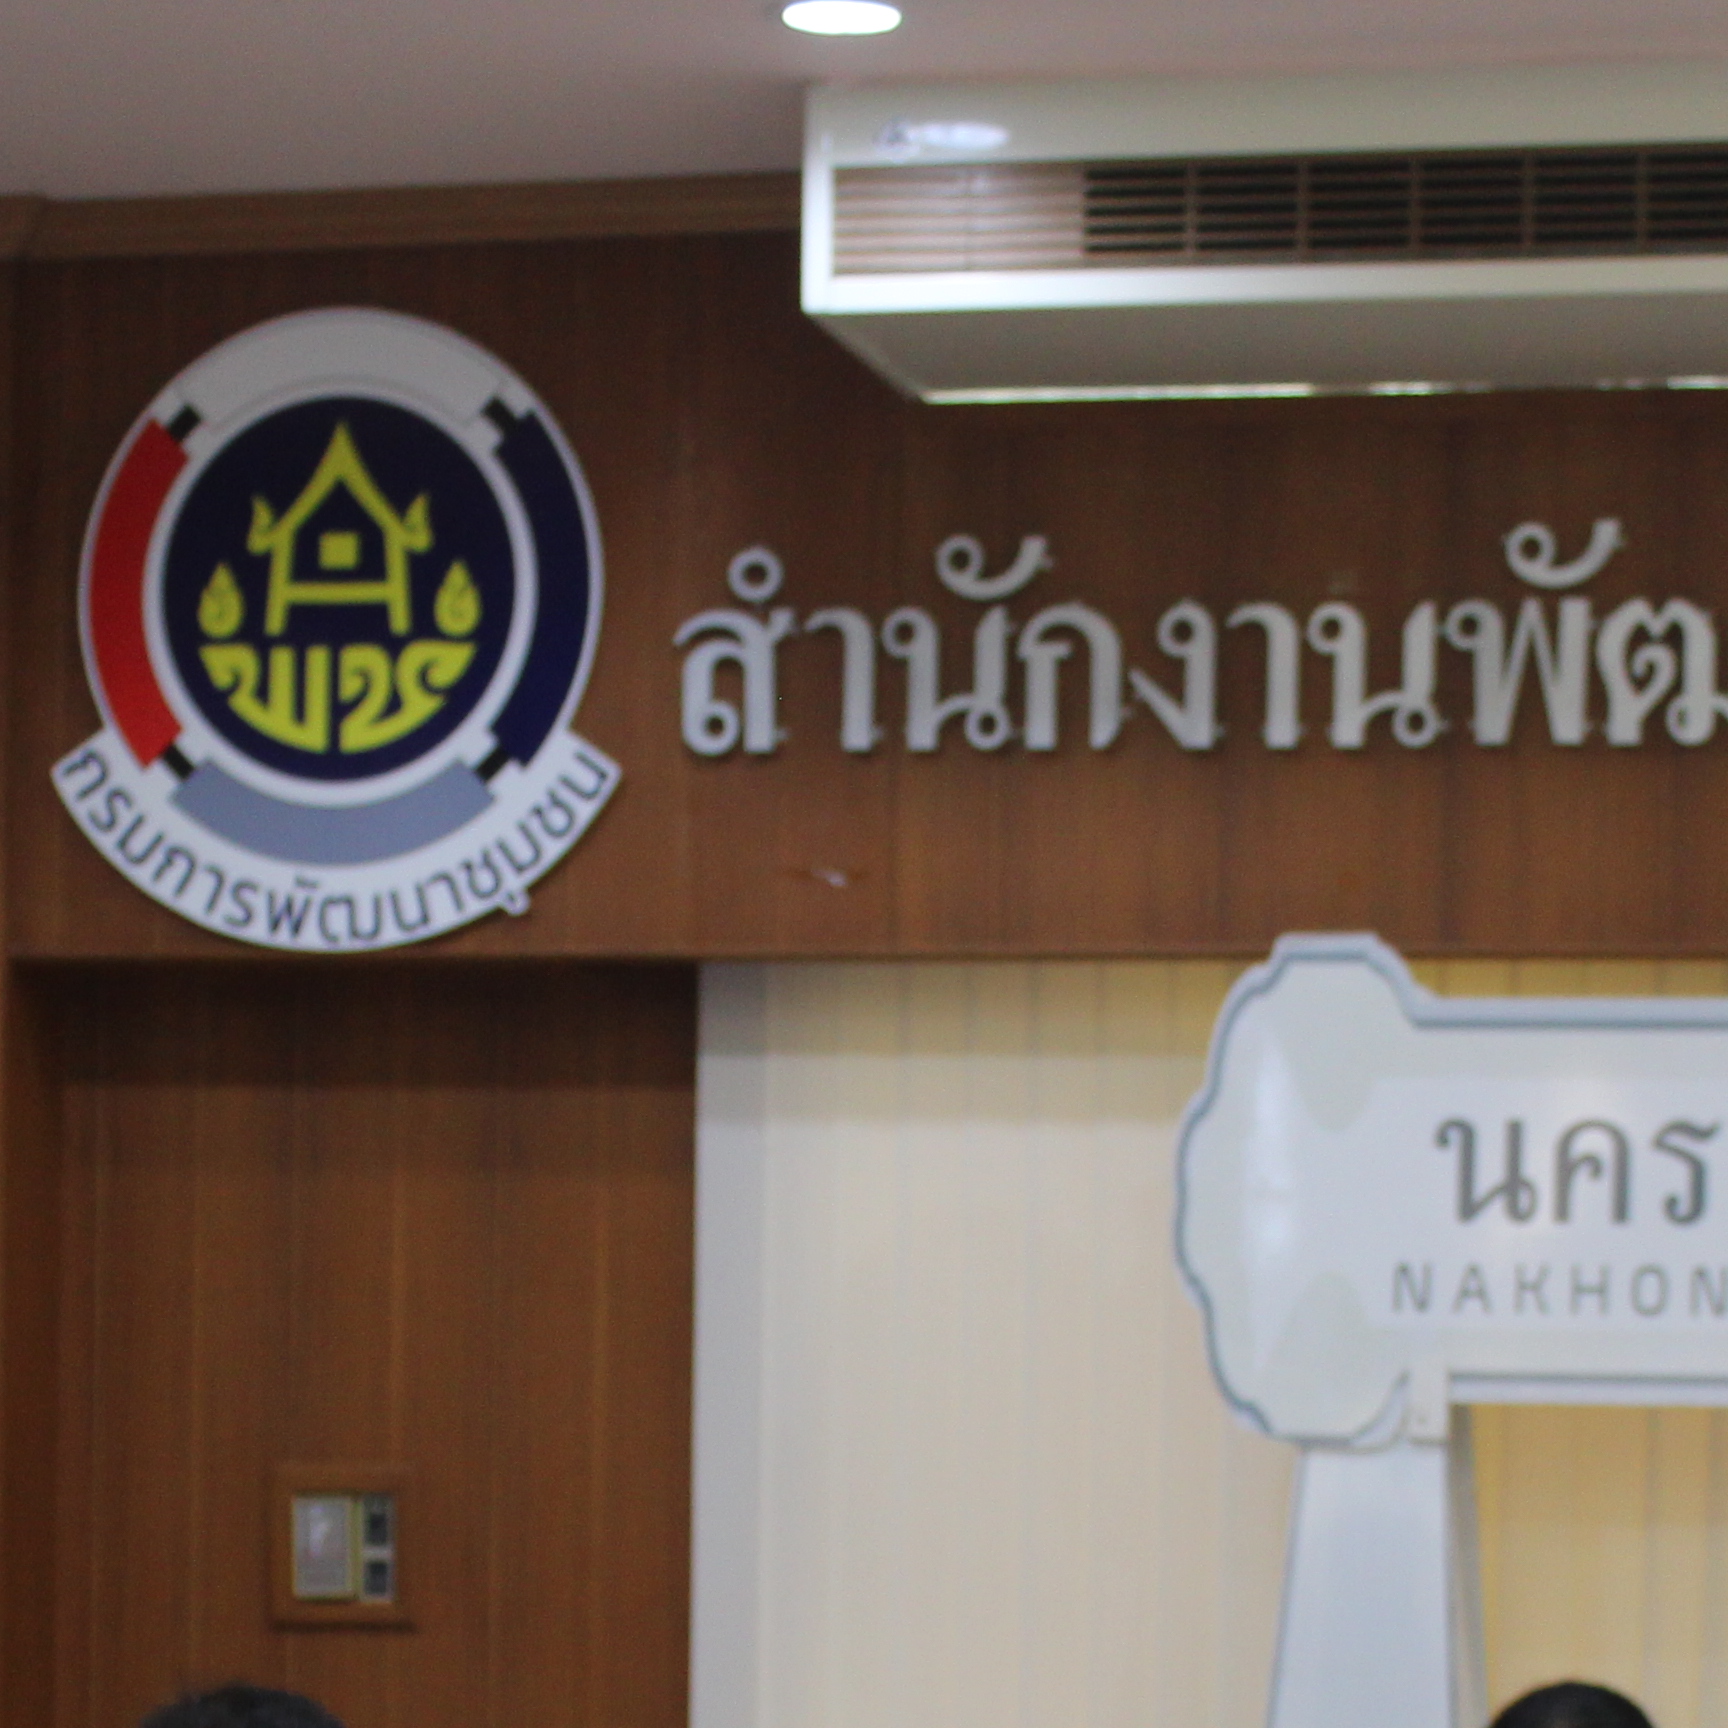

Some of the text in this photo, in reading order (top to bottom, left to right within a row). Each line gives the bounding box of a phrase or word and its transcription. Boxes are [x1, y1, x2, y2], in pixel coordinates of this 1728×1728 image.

[60, 745, 617, 942] กรมการพัฒนาชุมชน
